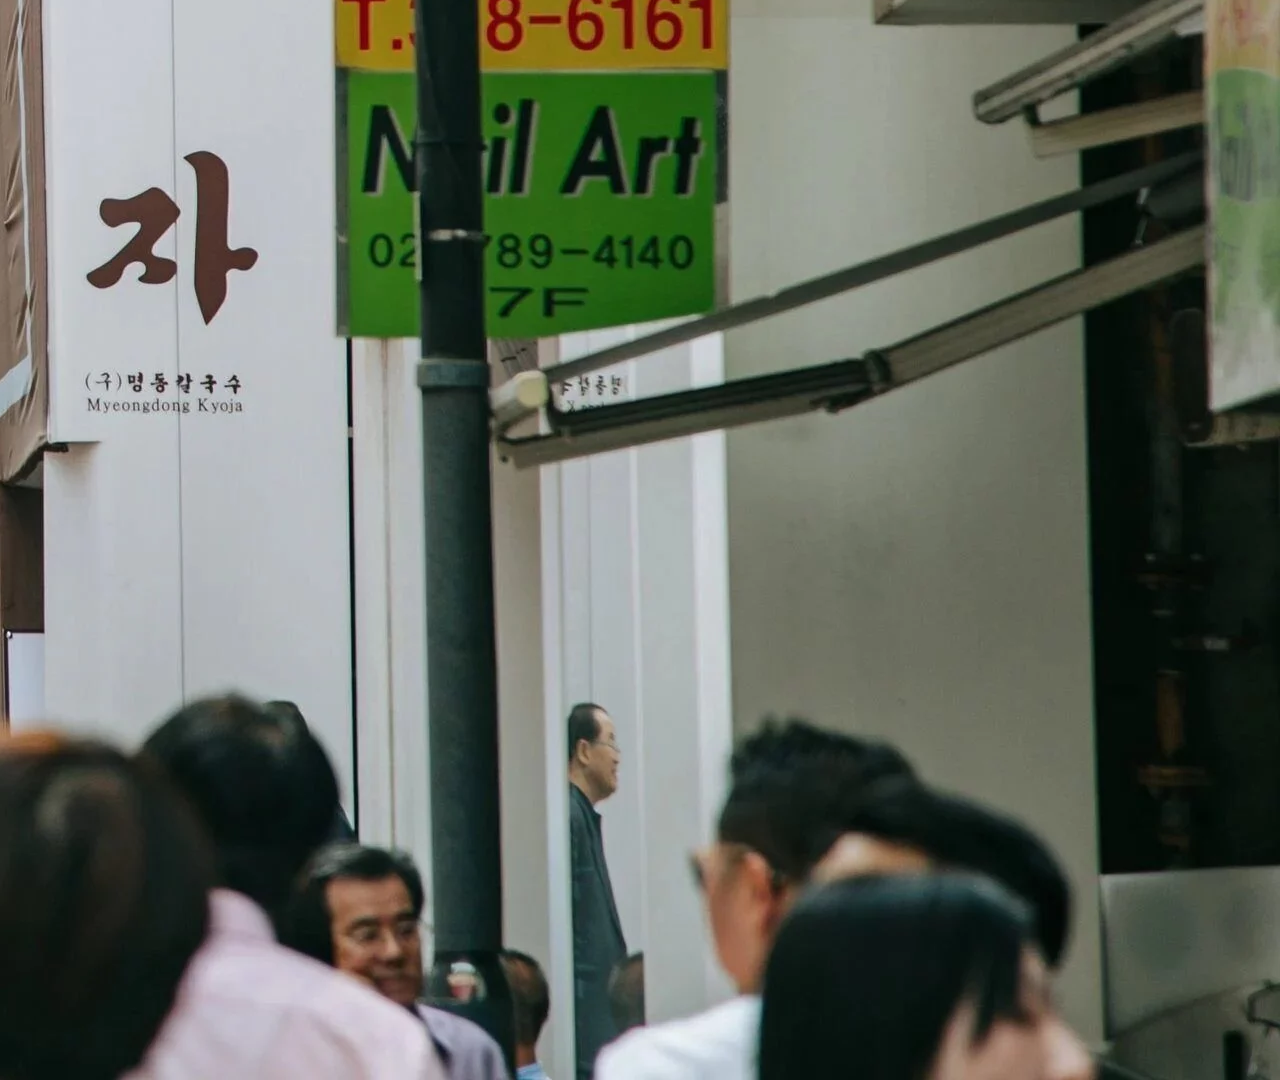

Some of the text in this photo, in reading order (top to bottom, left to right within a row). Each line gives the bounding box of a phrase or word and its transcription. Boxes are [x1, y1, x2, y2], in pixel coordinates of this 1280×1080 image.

[361, 98, 704, 196] Nil Art
[488, 287, 590, 318] 7F
[87, 398, 244, 413] Myeongdong Kyoja
